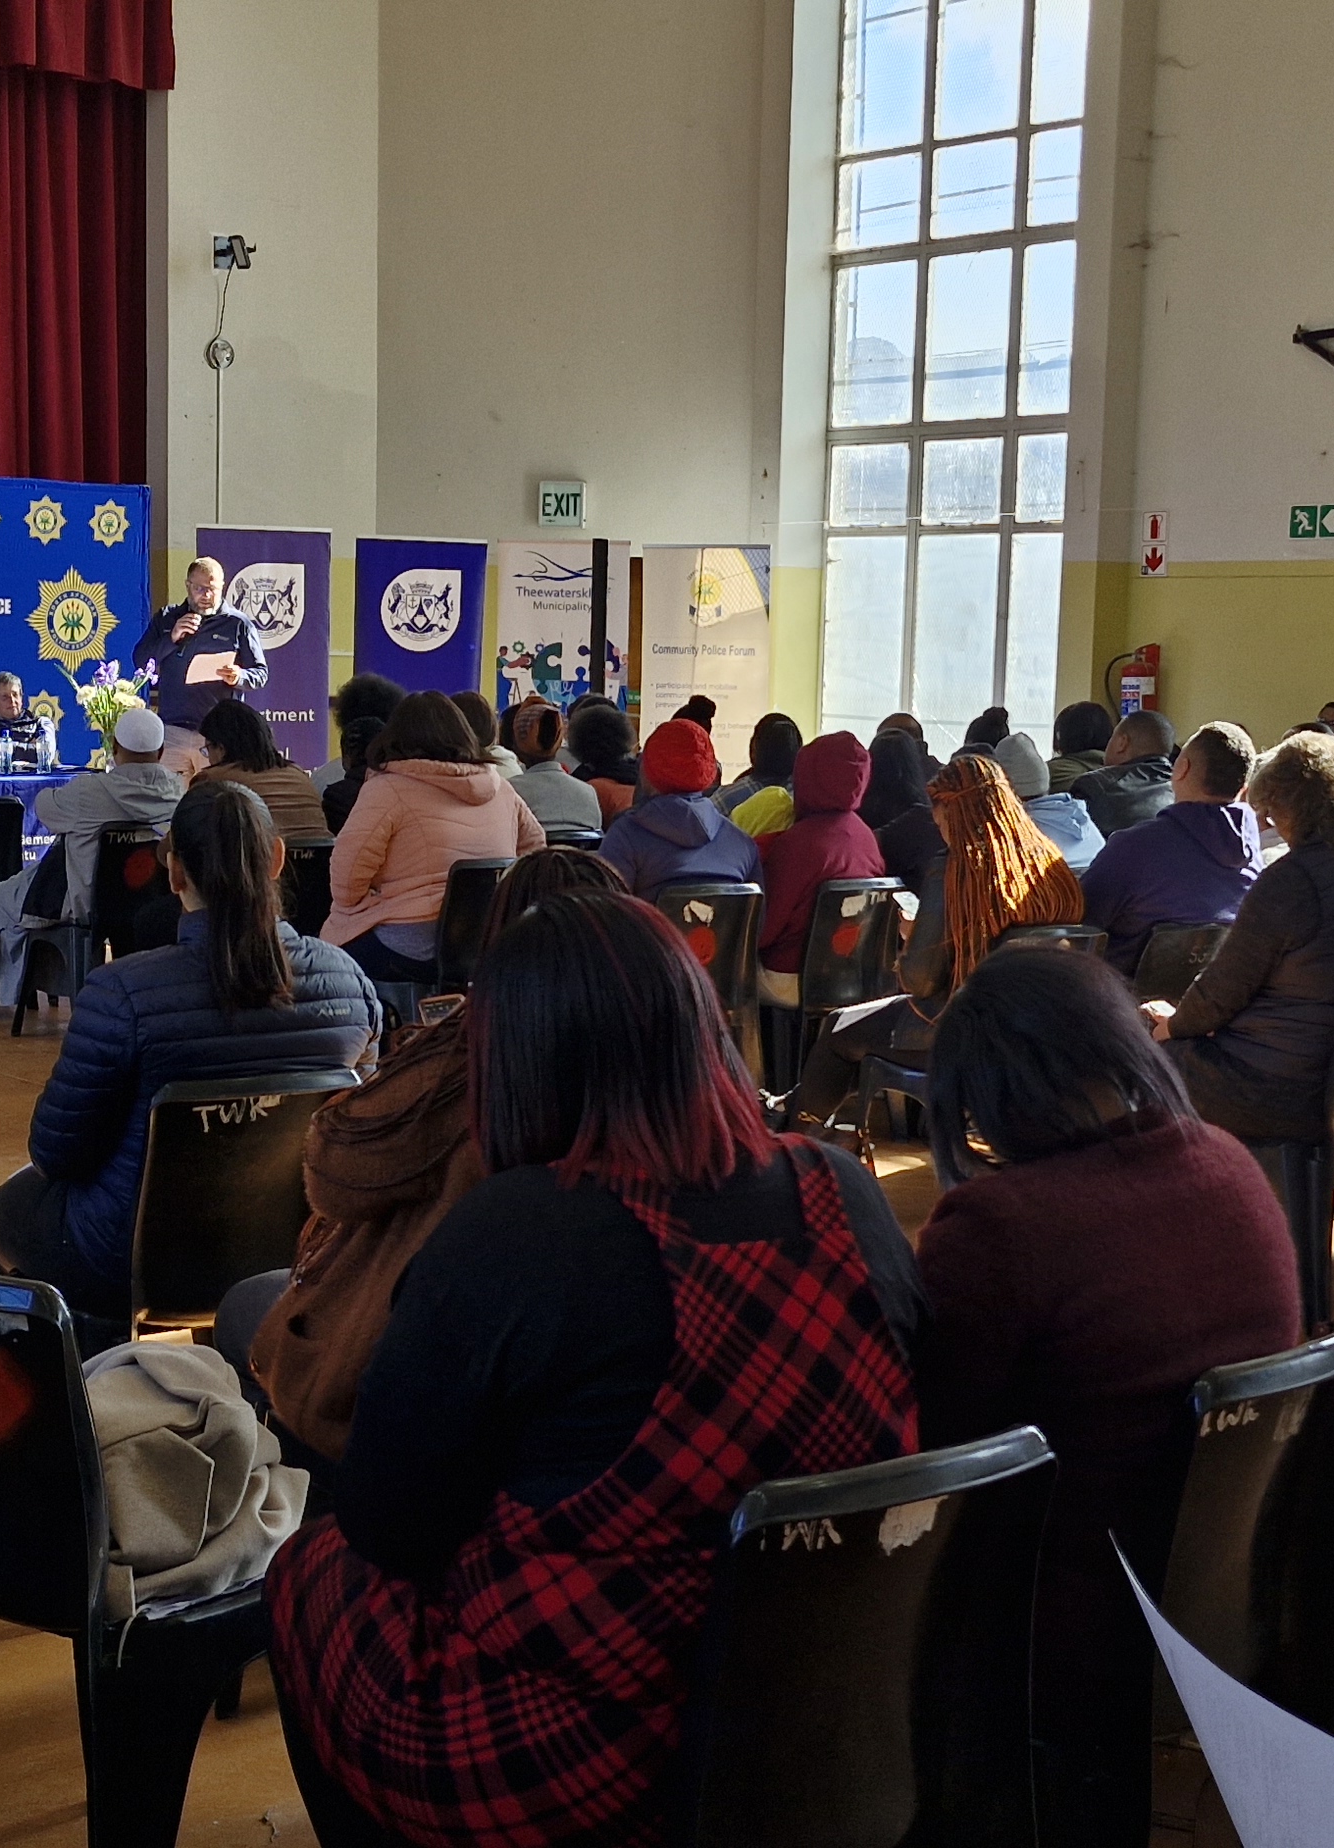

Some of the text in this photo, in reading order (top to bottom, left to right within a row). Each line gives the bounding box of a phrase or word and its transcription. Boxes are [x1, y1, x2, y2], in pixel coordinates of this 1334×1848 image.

[542, 492, 581, 517] EXIT
[515, 586, 611, 598] Theewaterskl
[533, 600, 592, 613] Municipality
[652, 643, 756, 657] Community Police Forum
[260, 708, 315, 722] tment
[192, 1096, 268, 1133] TWK
